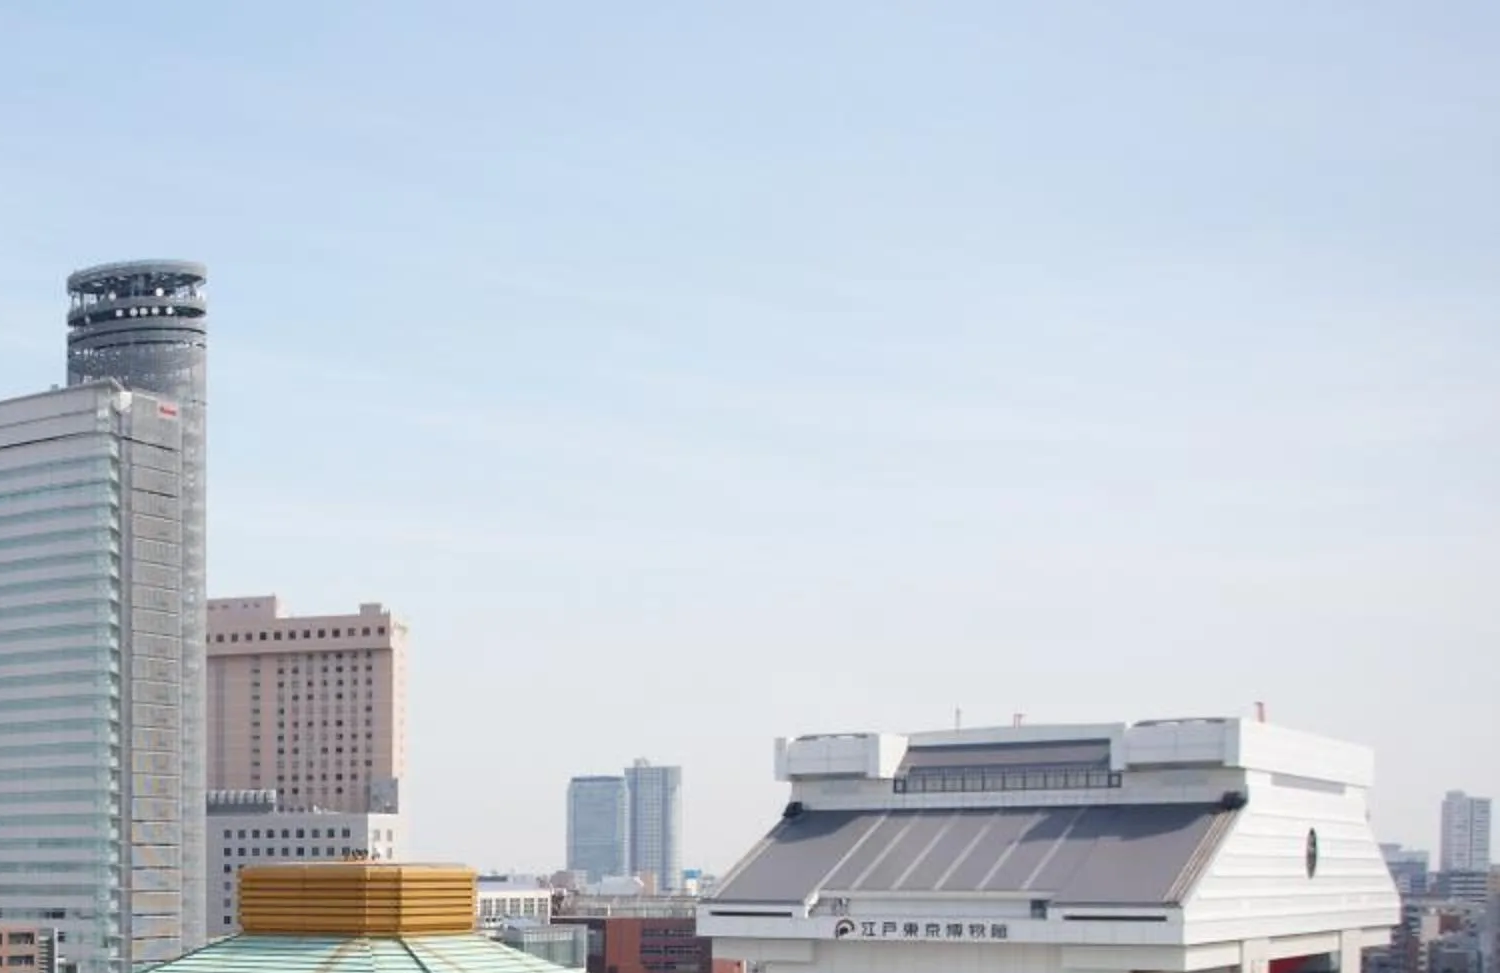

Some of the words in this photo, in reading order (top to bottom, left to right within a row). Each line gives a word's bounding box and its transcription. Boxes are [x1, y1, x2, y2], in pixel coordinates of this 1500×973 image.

[861, 921, 1008, 939] 江戸東京博物館
